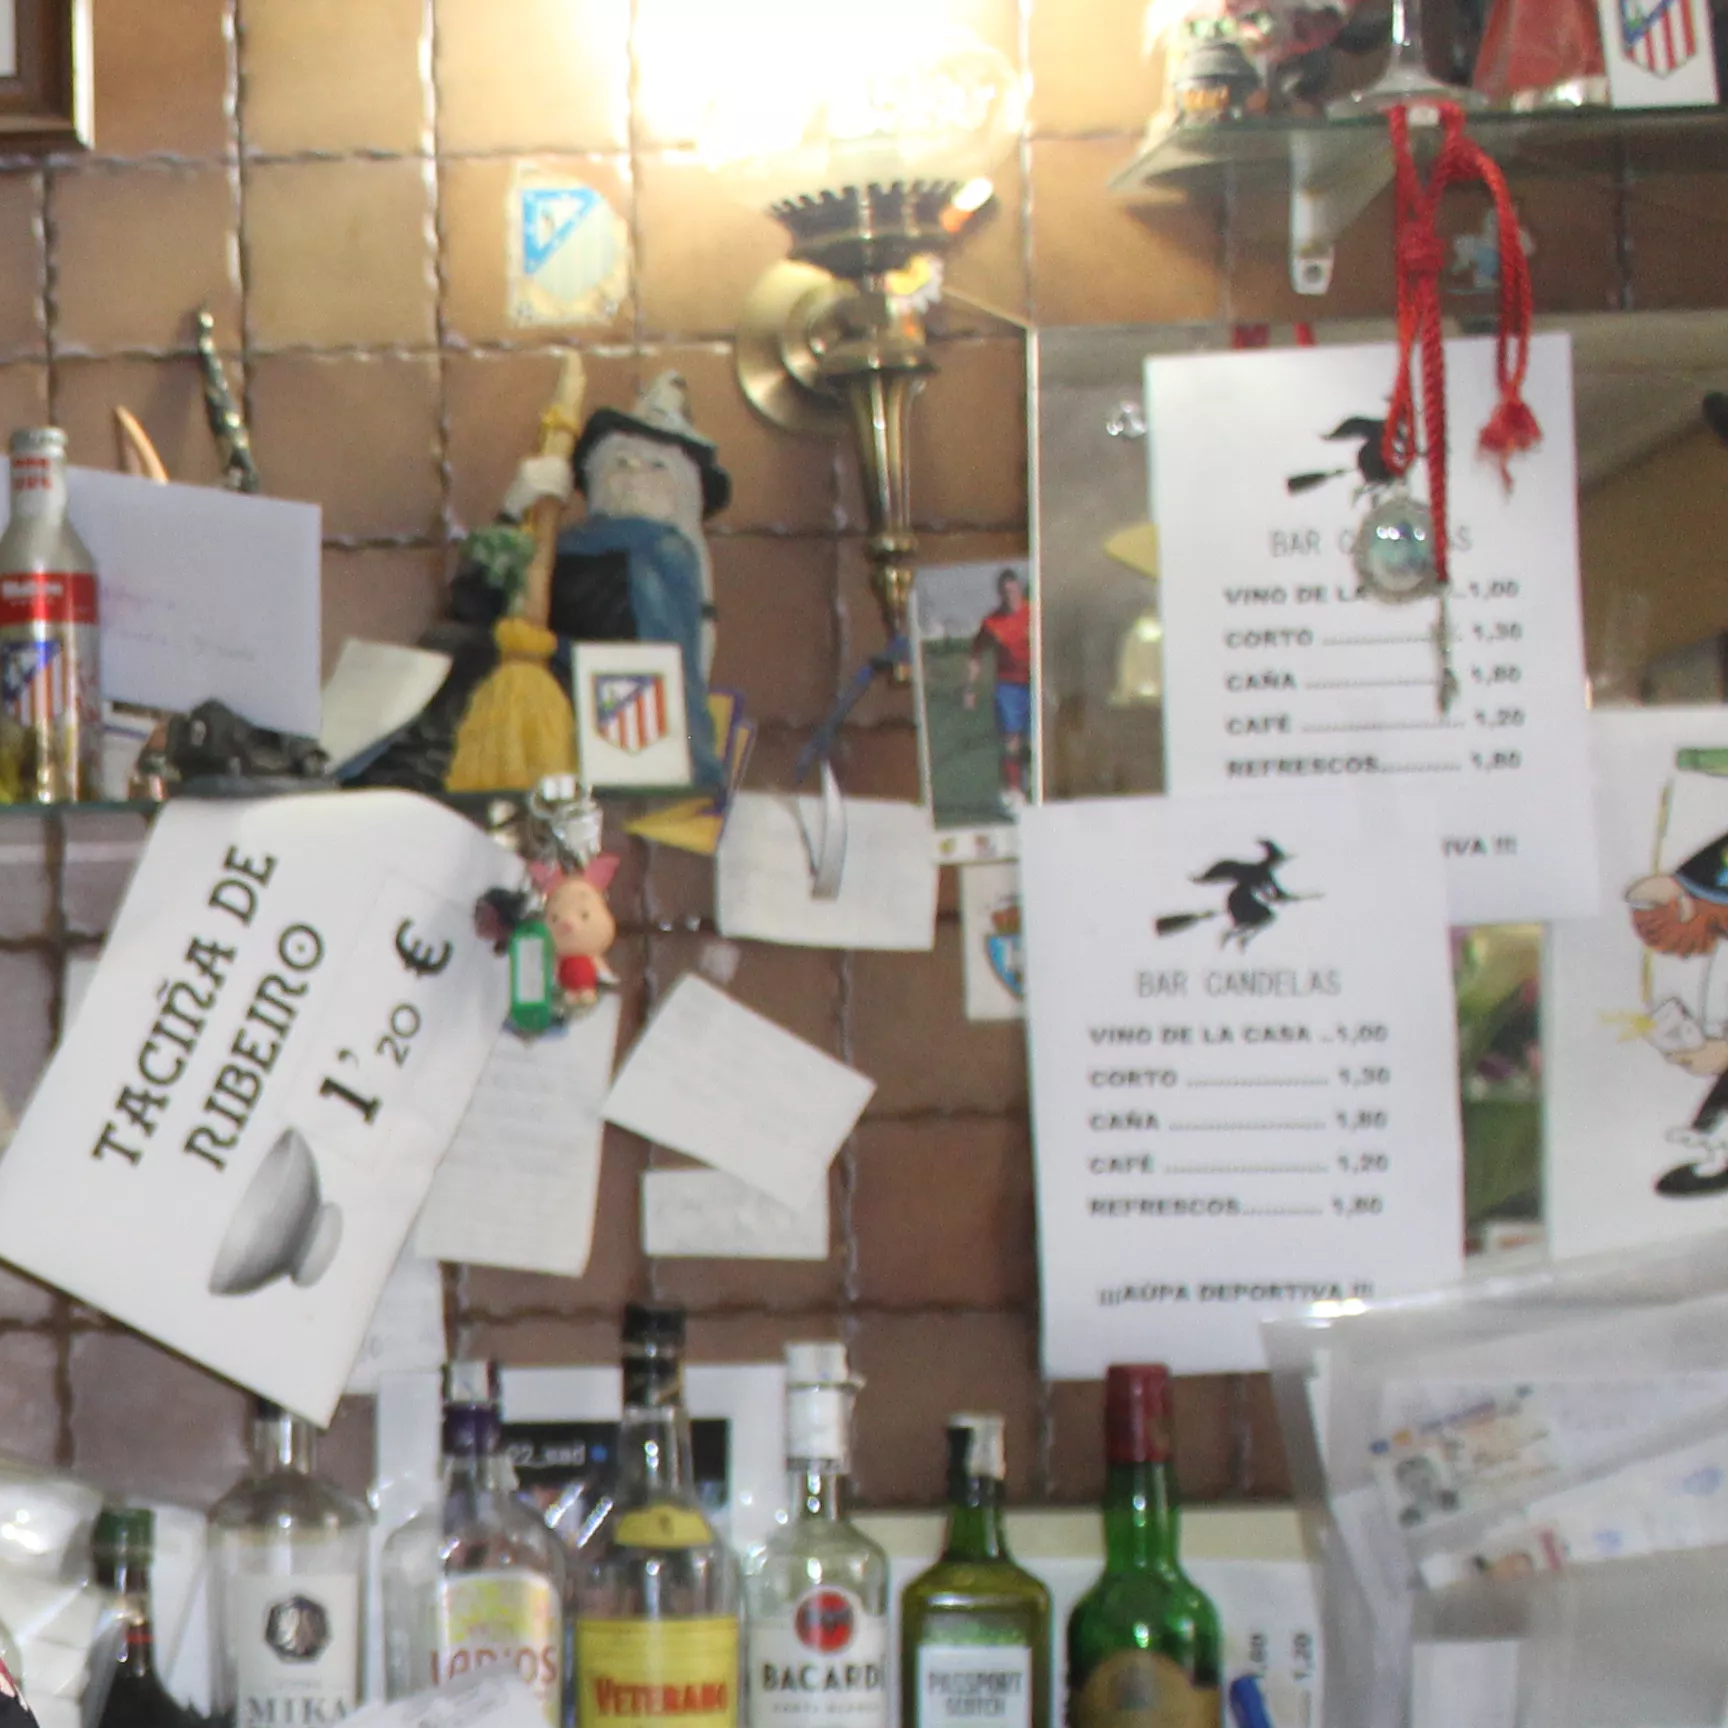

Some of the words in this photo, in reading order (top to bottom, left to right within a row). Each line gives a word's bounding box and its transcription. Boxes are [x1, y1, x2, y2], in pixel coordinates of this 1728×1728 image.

[1269, 529, 1321, 556] BAR
[1225, 586, 1287, 605] VINO
[1297, 584, 1327, 601] DE
[1224, 628, 1314, 649] CORTO
[394, 916, 454, 981] €
[1137, 969, 1188, 997] BAR
[1205, 968, 1342, 997] CANDELAS
[92, 930, 237, 1169] TACIÑA
[208, 844, 278, 927] DE
[182, 921, 324, 1173] RIBEIRO
[1089, 1026, 1153, 1046] VINO
[1160, 1026, 1192, 1045] DE
[1202, 1026, 1235, 1045] LA
[1243, 1026, 1313, 1045] CASA
[1090, 1069, 1179, 1089] CORTO
[1198, 1279, 1344, 1302] DEPORTIVA
